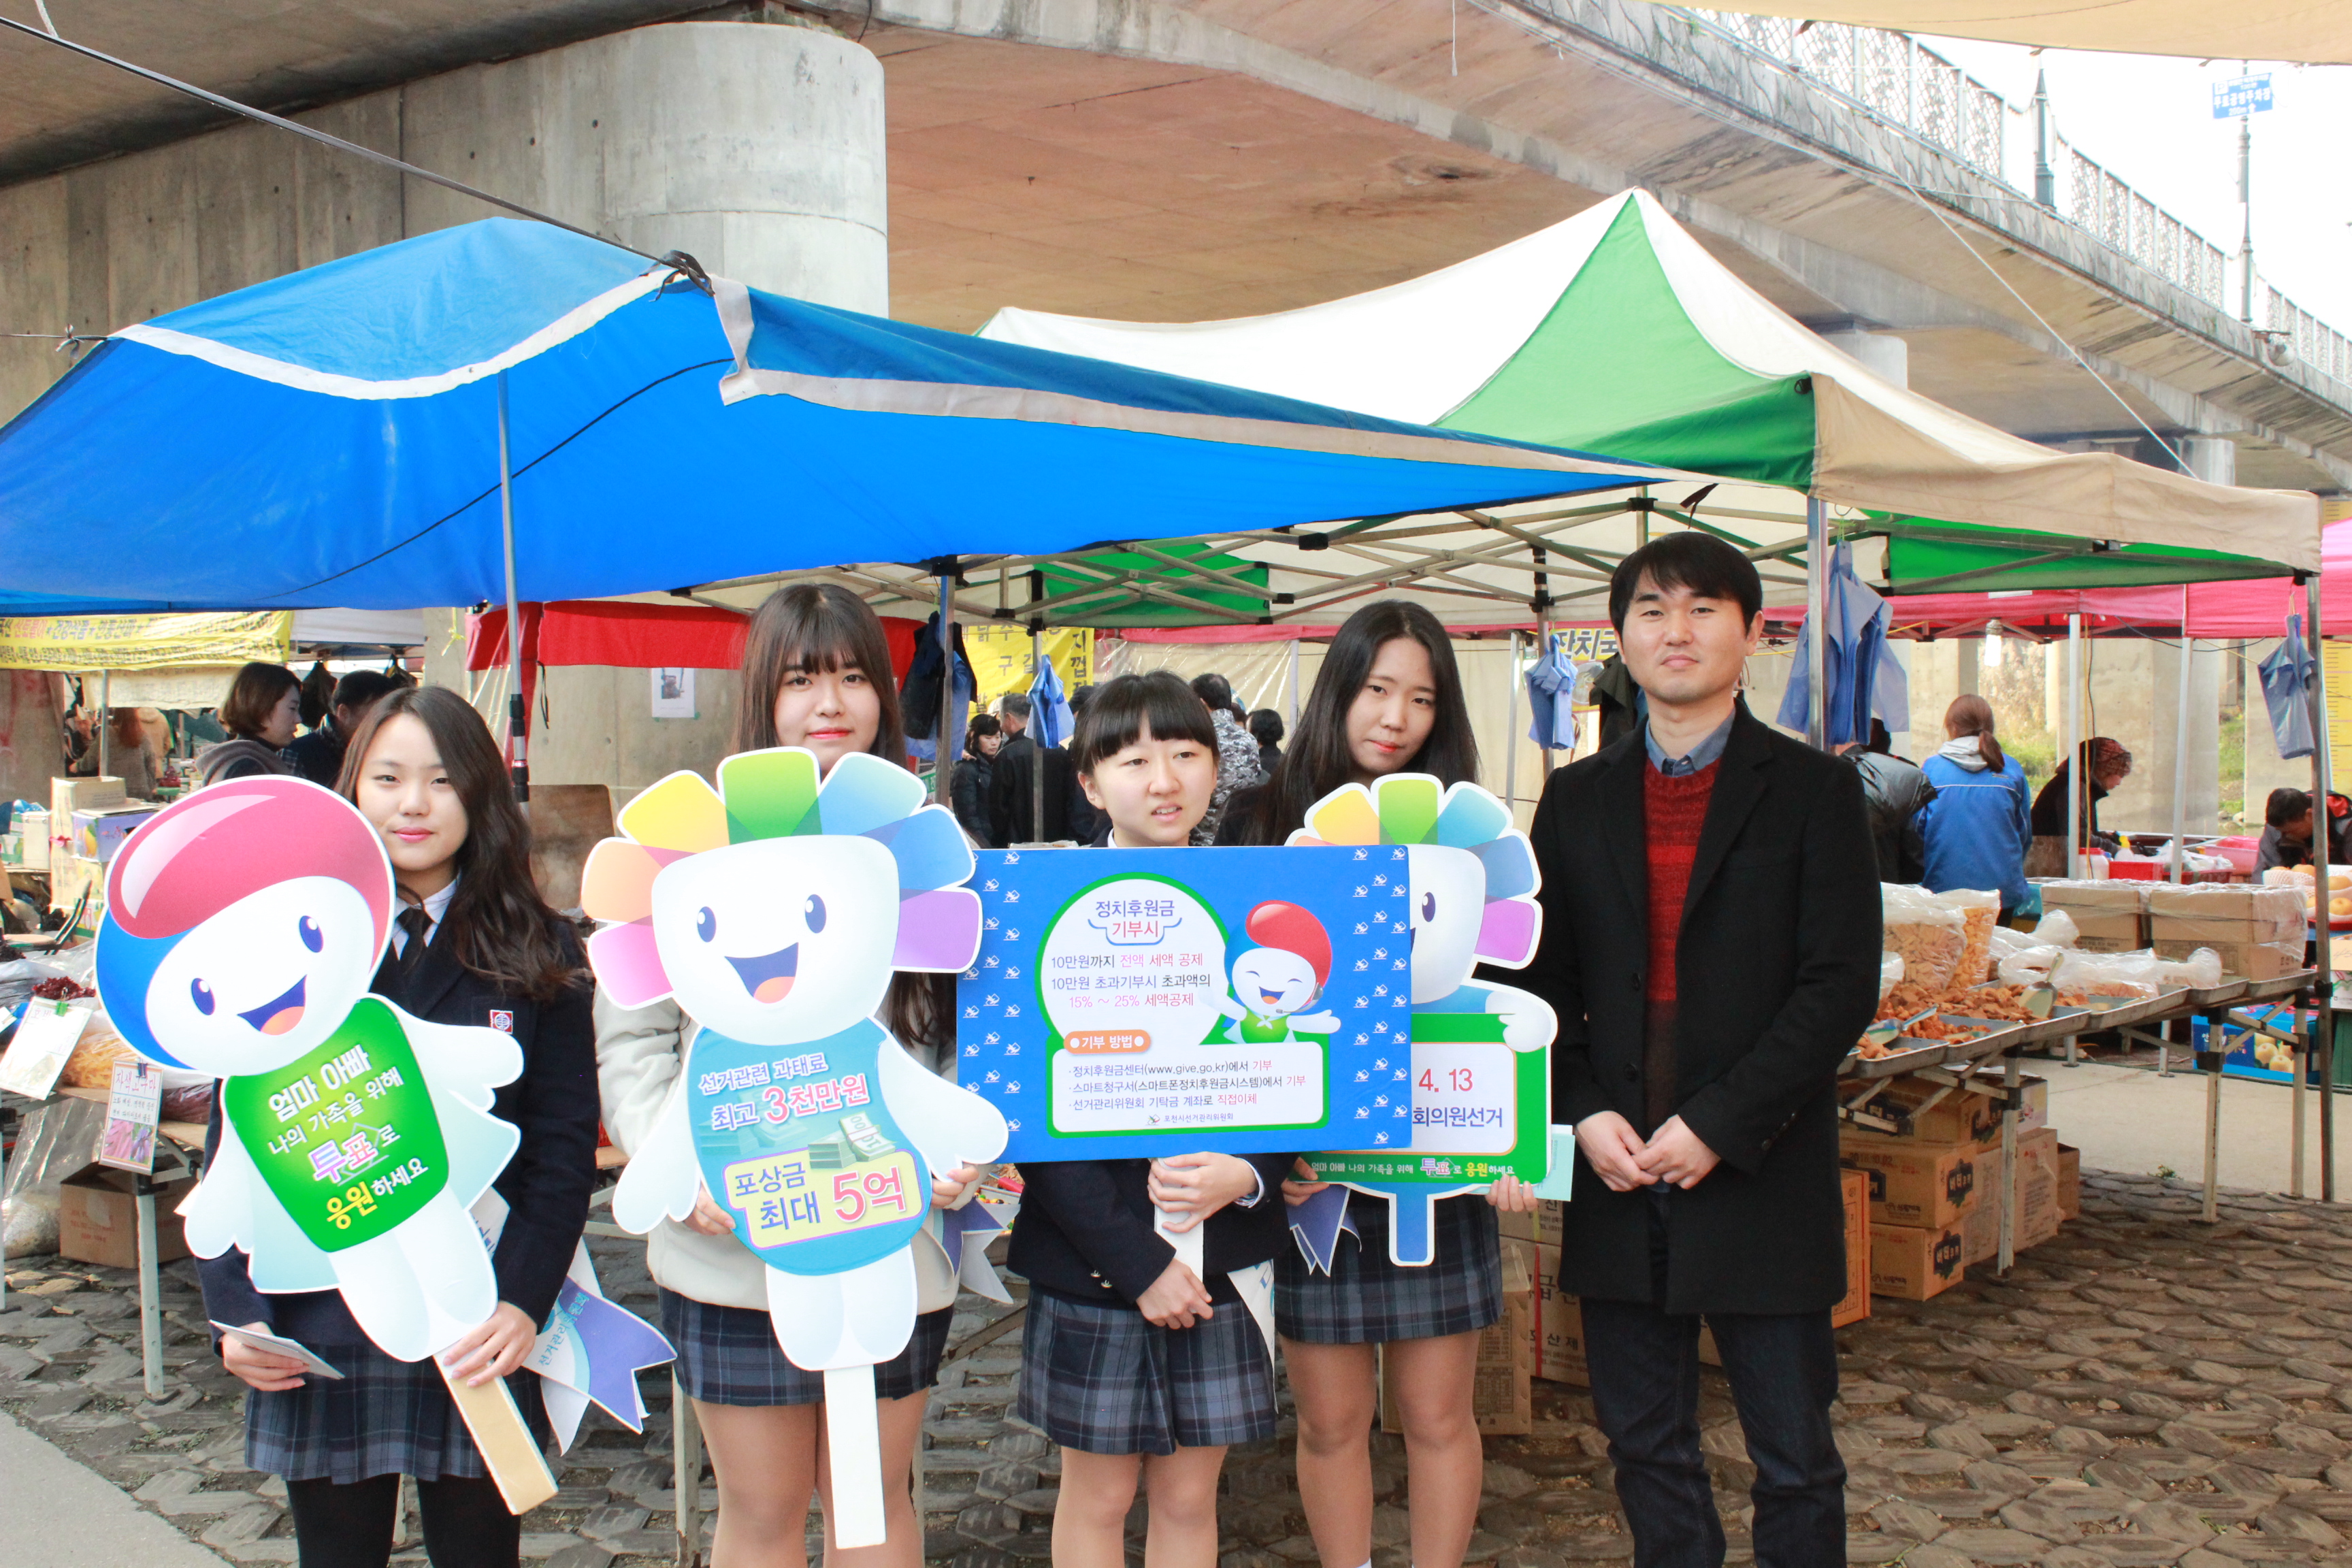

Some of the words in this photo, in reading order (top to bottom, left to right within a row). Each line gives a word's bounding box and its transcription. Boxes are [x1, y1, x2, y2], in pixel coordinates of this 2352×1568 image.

[1095, 900, 1175, 918] 정치후원금
[1112, 921, 1159, 938] 기부시
[1051, 955, 1115, 969] 10만원까지
[1120, 954, 1145, 968] 전액
[1149, 953, 1173, 967] 세액
[1179, 953, 1203, 966] 공제
[1051, 976, 1090, 990] 10만원
[1095, 975, 1157, 990] 초과기부시
[1162, 973, 1211, 987] 초과액의
[1069, 996, 1093, 1008] 15%
[1115, 995, 1140, 1007] 25%
[1144, 993, 1194, 1007] 세액공제
[1081, 1036, 1106, 1049] 기부
[1109, 1035, 1133, 1049] 방법
[700, 1063, 770, 1096] 선거관련
[773, 1052, 829, 1081] 과태료
[1253, 1060, 1273, 1072] 기부
[268, 1075, 321, 1123] 엄마
[319, 1043, 374, 1091] 아빠
[1286, 1075, 1306, 1086] 기부
[712, 1101, 760, 1131] 최고
[763, 1073, 870, 1124] 3천만원
[1073, 1097, 1145, 1111] 선거관리위원회
[1149, 1096, 1179, 1108] 기탁금
[1183, 1095, 1213, 1107] 계좌로
[1217, 1093, 1258, 1105] 직접이체
[267, 1124, 308, 1156] 나의
[308, 1092, 365, 1132] 가족을
[364, 1066, 406, 1101] 위해
[1164, 1112, 1234, 1124] 포천시선거관리위원회
[1412, 1107, 1503, 1128] 회의원선거
[1311, 1162, 1328, 1172] 엄마
[1329, 1162, 1345, 1172] 아빠
[1348, 1163, 1365, 1173] 나의
[1368, 1164, 1394, 1175] 가족을
[1396, 1164, 1414, 1174] 위해
[734, 1160, 806, 1198] 포상금
[760, 1190, 822, 1232] 최대
[831, 1165, 907, 1223] 5억
